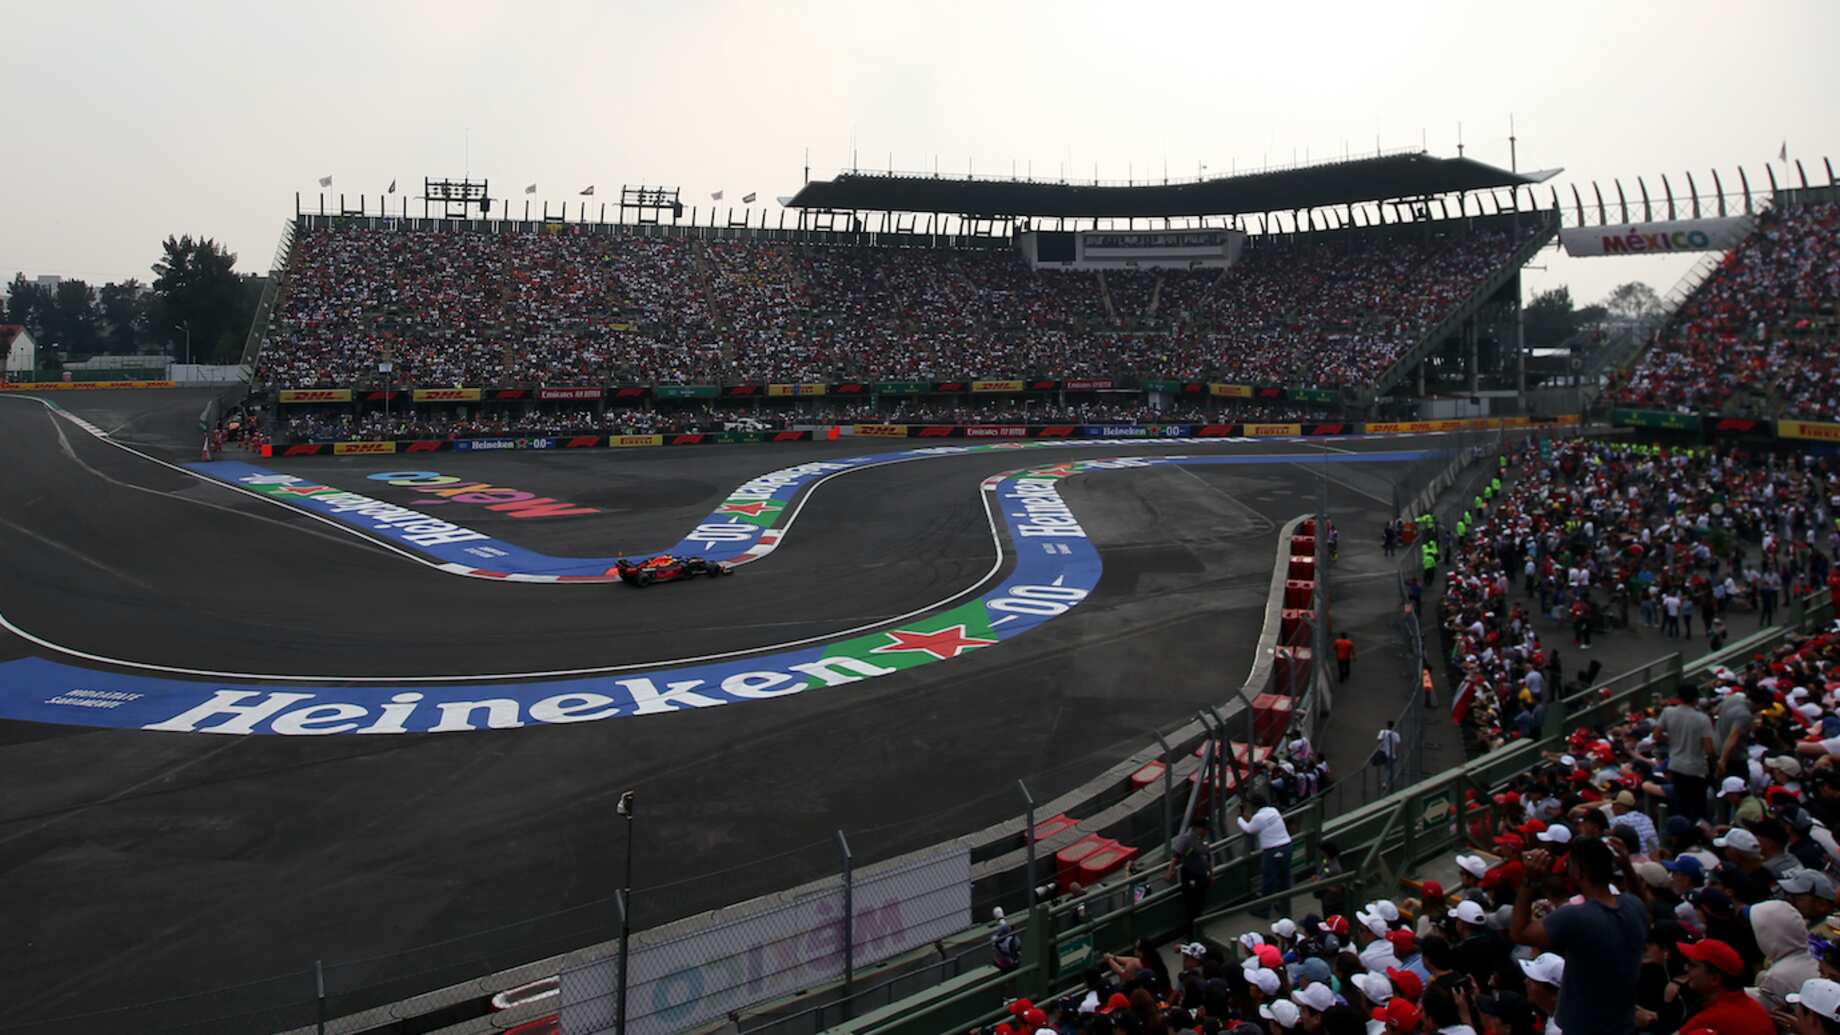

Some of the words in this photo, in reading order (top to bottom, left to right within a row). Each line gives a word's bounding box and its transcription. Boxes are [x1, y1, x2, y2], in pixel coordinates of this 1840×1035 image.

[294, 391, 334, 401] DHL
[425, 390, 464, 400] DHL
[541, 390, 574, 399] Emirates
[861, 426, 896, 434] DHL
[967, 427, 998, 437] Emirates
[1103, 426, 1147, 437] Heineken
[1373, 424, 1400, 432] DHL
[345, 444, 383, 453] DHL
[472, 438, 514, 449] Heineken
[1004, 479, 1087, 537] Heineken
[141, 655, 897, 736] Heineken
